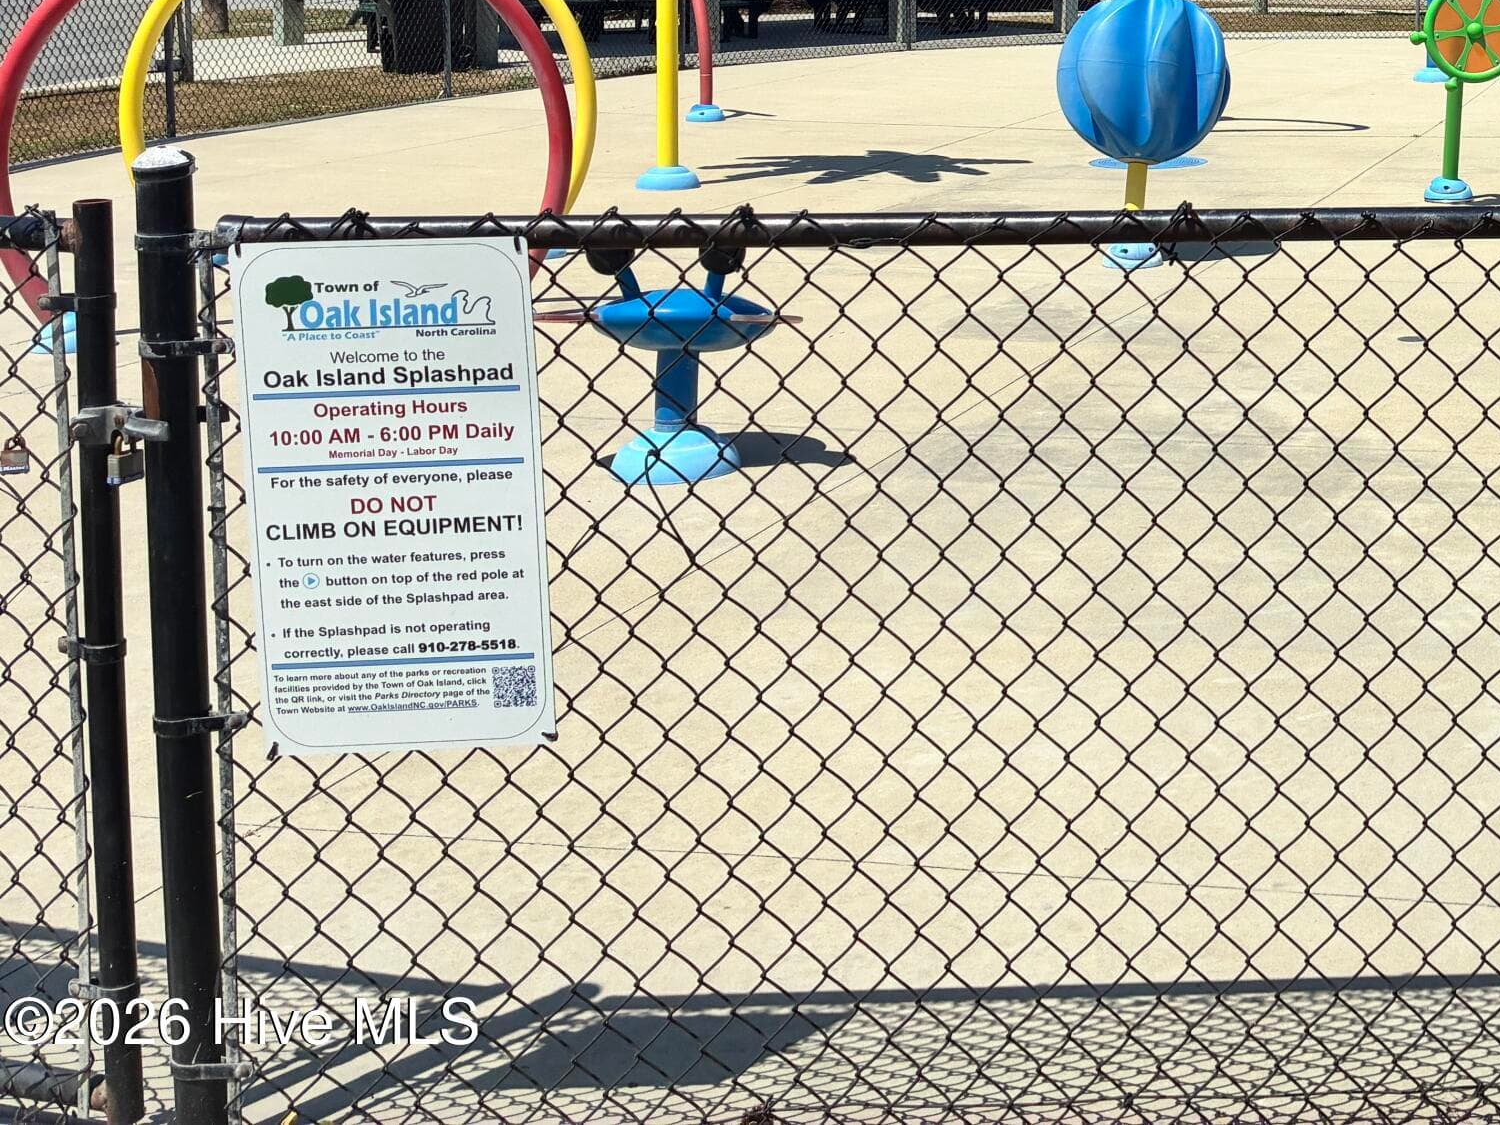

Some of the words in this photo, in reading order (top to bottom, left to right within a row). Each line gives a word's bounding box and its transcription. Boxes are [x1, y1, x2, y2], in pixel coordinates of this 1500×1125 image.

[313, 282, 358, 293] Town
[362, 280, 379, 291] of
[299, 299, 361, 328] Oak
[369, 296, 458, 326] Island
[298, 332, 327, 341] Place
[330, 332, 342, 340] to
[415, 328, 448, 337] North
[450, 326, 496, 336] Carolina
[329, 350, 399, 363] Welcome
[403, 349, 417, 361] to
[421, 348, 445, 361] the
[263, 369, 309, 388] Oak
[316, 366, 385, 386] Island
[392, 362, 513, 387] Splashpad
[313, 400, 405, 421] Operating
[411, 399, 467, 414] Hours
[269, 429, 322, 446] 10:00
[328, 427, 360, 444] AM
[379, 425, 421, 442] 6:00
[428, 423, 458, 440] PM
[465, 421, 514, 441] Daily
[328, 448, 375, 458] Memorial
[377, 447, 397, 458] Day
[406, 446, 436, 455] Labor
[438, 445, 458, 456] Day
[270, 476, 295, 489] For
[298, 475, 321, 487] the
[325, 474, 369, 488] safety
[373, 472, 388, 484] of
[391, 472, 462, 485] everyone,
[466, 468, 512, 483] please
[350, 497, 383, 514] DO
[390, 494, 437, 513] NOT
[265, 522, 336, 541] CLIMB
[343, 520, 376, 538] ON
[383, 514, 522, 536] EQUIPMENT!
[277, 556, 293, 567] To
[296, 557, 323, 567] turn
[326, 557, 343, 565] on
[346, 553, 367, 565] the
[370, 553, 406, 563] water
[409, 551, 466, 562] features,
[469, 550, 505, 562] press
[278, 577, 299, 588] the
[325, 575, 367, 586] button
[371, 575, 387, 584] on
[390, 573, 412, 585] top
[415, 571, 429, 582] of
[432, 570, 452, 582] the
[456, 569, 477, 580] red
[480, 568, 508, 582] pole
[511, 568, 524, 578] at
[280, 597, 300, 609] the
[304, 596, 332, 607] east
[335, 595, 362, 606] side
[365, 594, 378, 605] of
[381, 593, 402, 604] the
[406, 590, 474, 605] Splashpad
[477, 591, 508, 600] area.
[282, 627, 291, 638] If
[294, 627, 314, 638] the
[318, 623, 386, 639] Splashpad
[390, 623, 401, 633] is
[404, 622, 426, 633] not
[429, 619, 490, 634] operating
[284, 646, 343, 659] correctly,
[347, 645, 388, 658] please
[392, 642, 414, 654] call
[417, 638, 520, 653] 910-278-5518.
[273, 674, 284, 682] To
[286, 674, 308, 682] learn
[334, 671, 358, 680] about
[360, 672, 376, 680] any
[378, 670, 387, 678] of
[405, 668, 429, 678] parks
[442, 666, 486, 675] recreation
[274, 685, 310, 693] facilities
[312, 682, 350, 693] provided
[352, 682, 363, 691] by
[380, 680, 404, 688] Town
[405, 679, 415, 687] of
[416, 679, 433, 687] Oak
[435, 677, 464, 686] Island,
[466, 676, 486, 685] click
[274, 696, 288, 704] the
[290, 695, 304, 703] QR
[306, 694, 324, 703] link,
[338, 693, 356, 701] visit
[358, 693, 372, 701] the
[374, 691, 399, 700] Parks
[400, 690, 440, 699] Directory
[442, 690, 463, 698] page
[465, 687, 474, 696] of
[476, 687, 490, 695] the
[300, 705, 335, 713] Website
[337, 704, 345, 712] at
